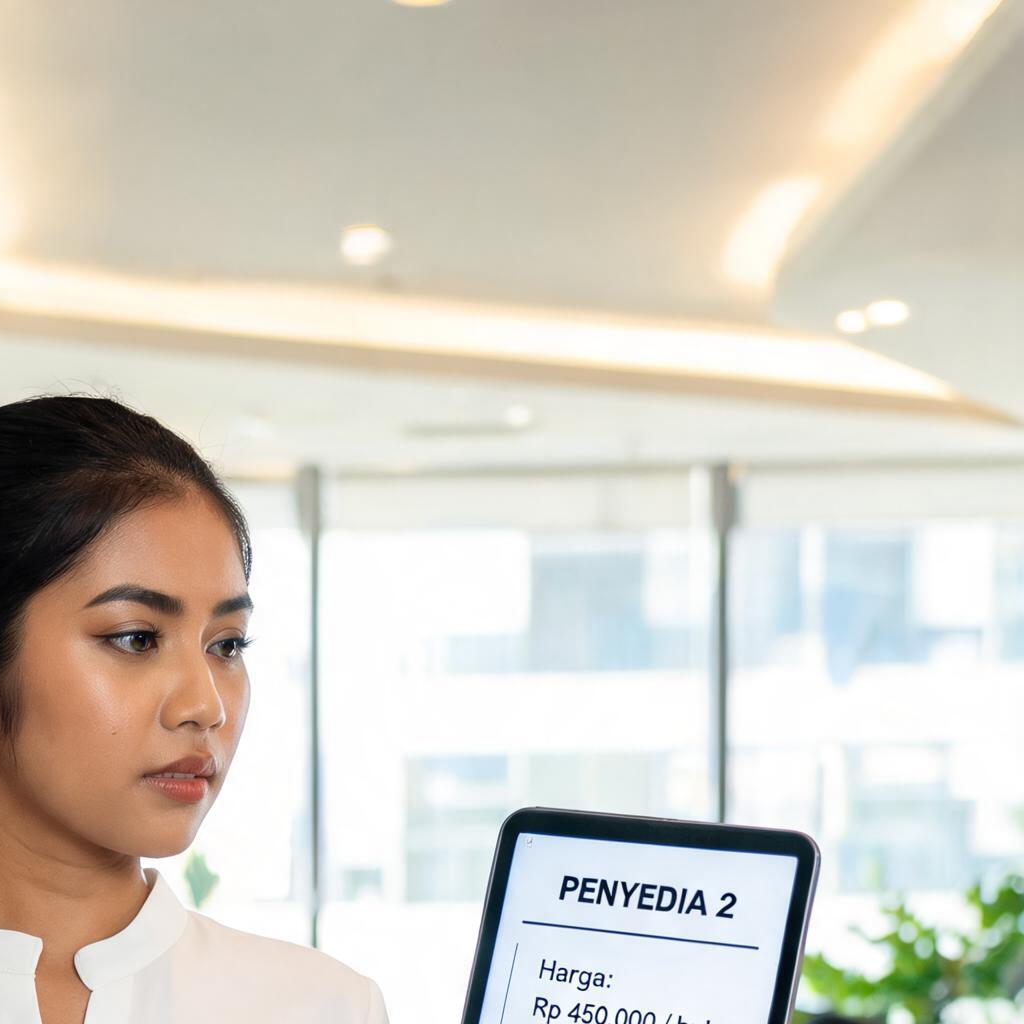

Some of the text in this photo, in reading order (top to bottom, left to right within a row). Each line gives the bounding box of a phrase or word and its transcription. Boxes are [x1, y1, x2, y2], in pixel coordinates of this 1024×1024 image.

[558, 875, 738, 920] PENYEDIA 2
[538, 958, 614, 992] Harga:
[532, 996, 562, 1024] Rp
